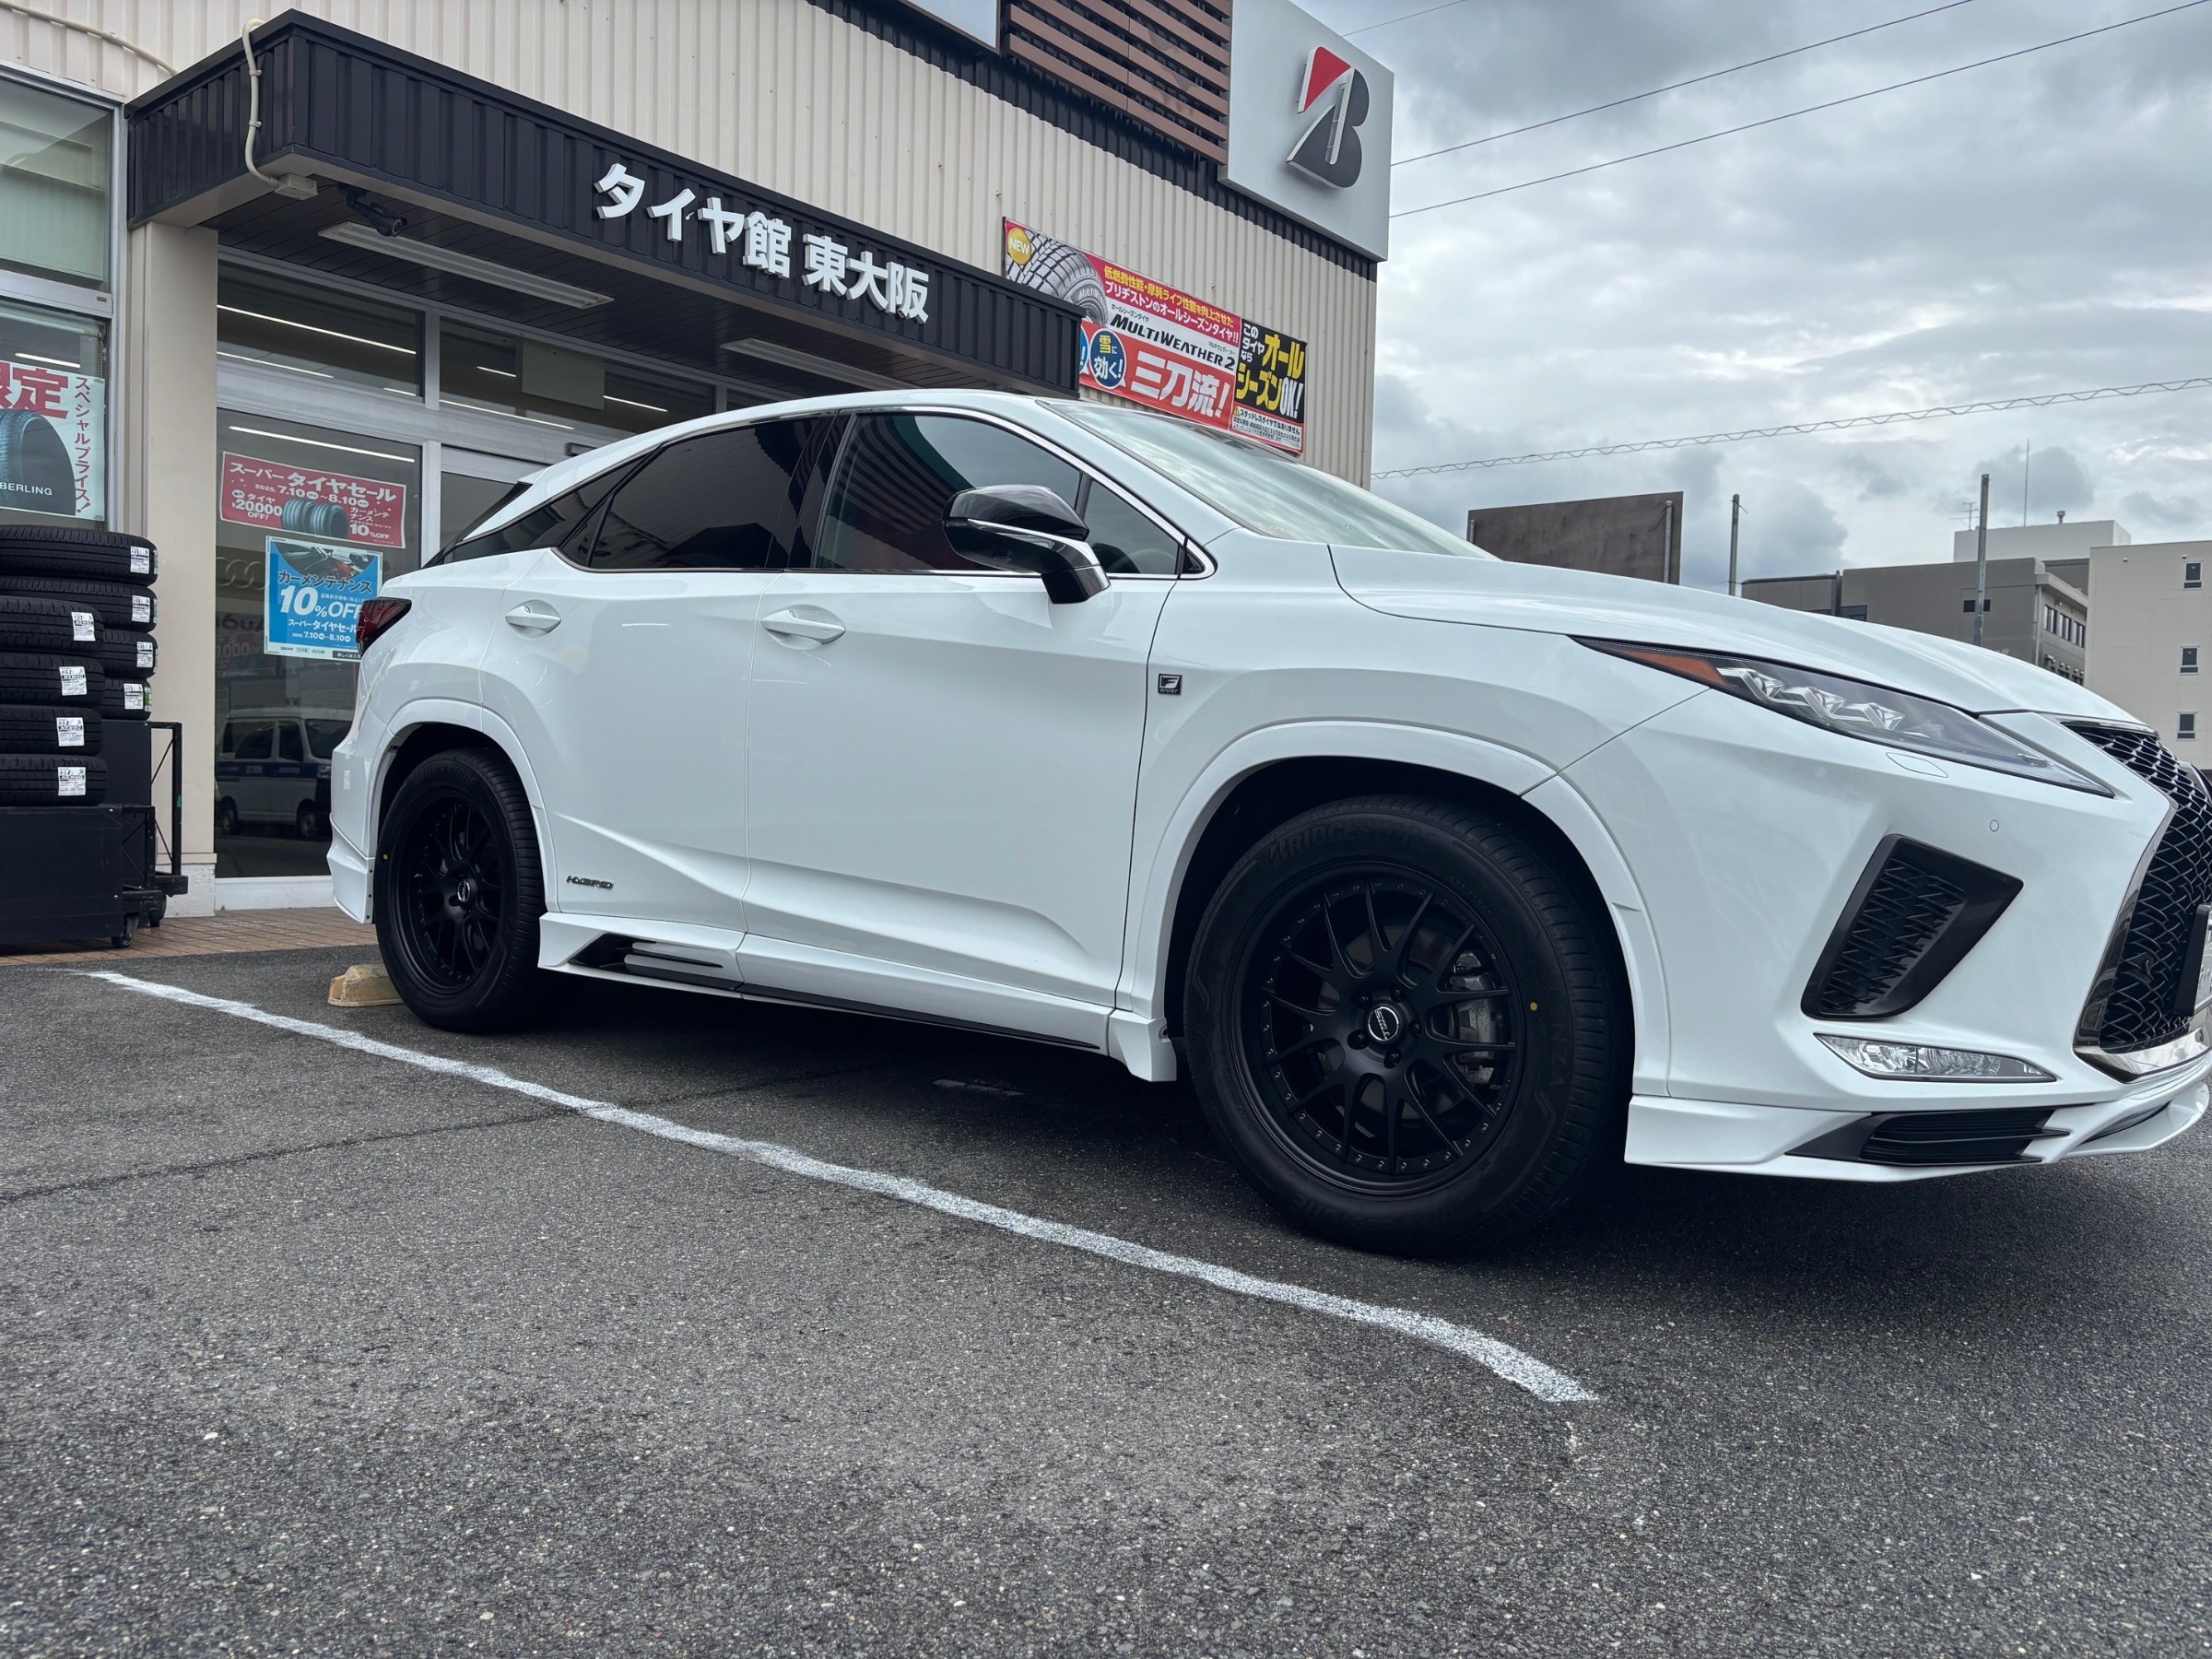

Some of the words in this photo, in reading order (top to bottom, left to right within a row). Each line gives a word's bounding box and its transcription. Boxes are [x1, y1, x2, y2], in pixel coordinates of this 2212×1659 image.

[594, 162, 792, 279] タイヤ館
[801, 232, 930, 324] 東大阪
[1009, 237, 1030, 255] NEW
[1110, 313, 1224, 368] MULTIWEATHER
[1224, 356, 1236, 371] 2
[1242, 323, 1259, 339] この
[1099, 335, 1118, 355] 雪に
[1240, 349, 1253, 363] なら
[1241, 337, 1265, 356] タイヤ
[1262, 334, 1305, 380] オール
[1093, 356, 1124, 381] 効く!
[0, 361, 69, 419] 定
[1130, 350, 1231, 418] 三刀流!
[74, 376, 91, 514] スペシャルプライス!
[229, 462, 396, 501] スーパータイヤセール
[247, 492, 276, 504] タイヤ
[247, 512, 269, 521] OFF!
[278, 570, 372, 594] カーメンテナンス
[566, 876, 615, 890] HYBRID
